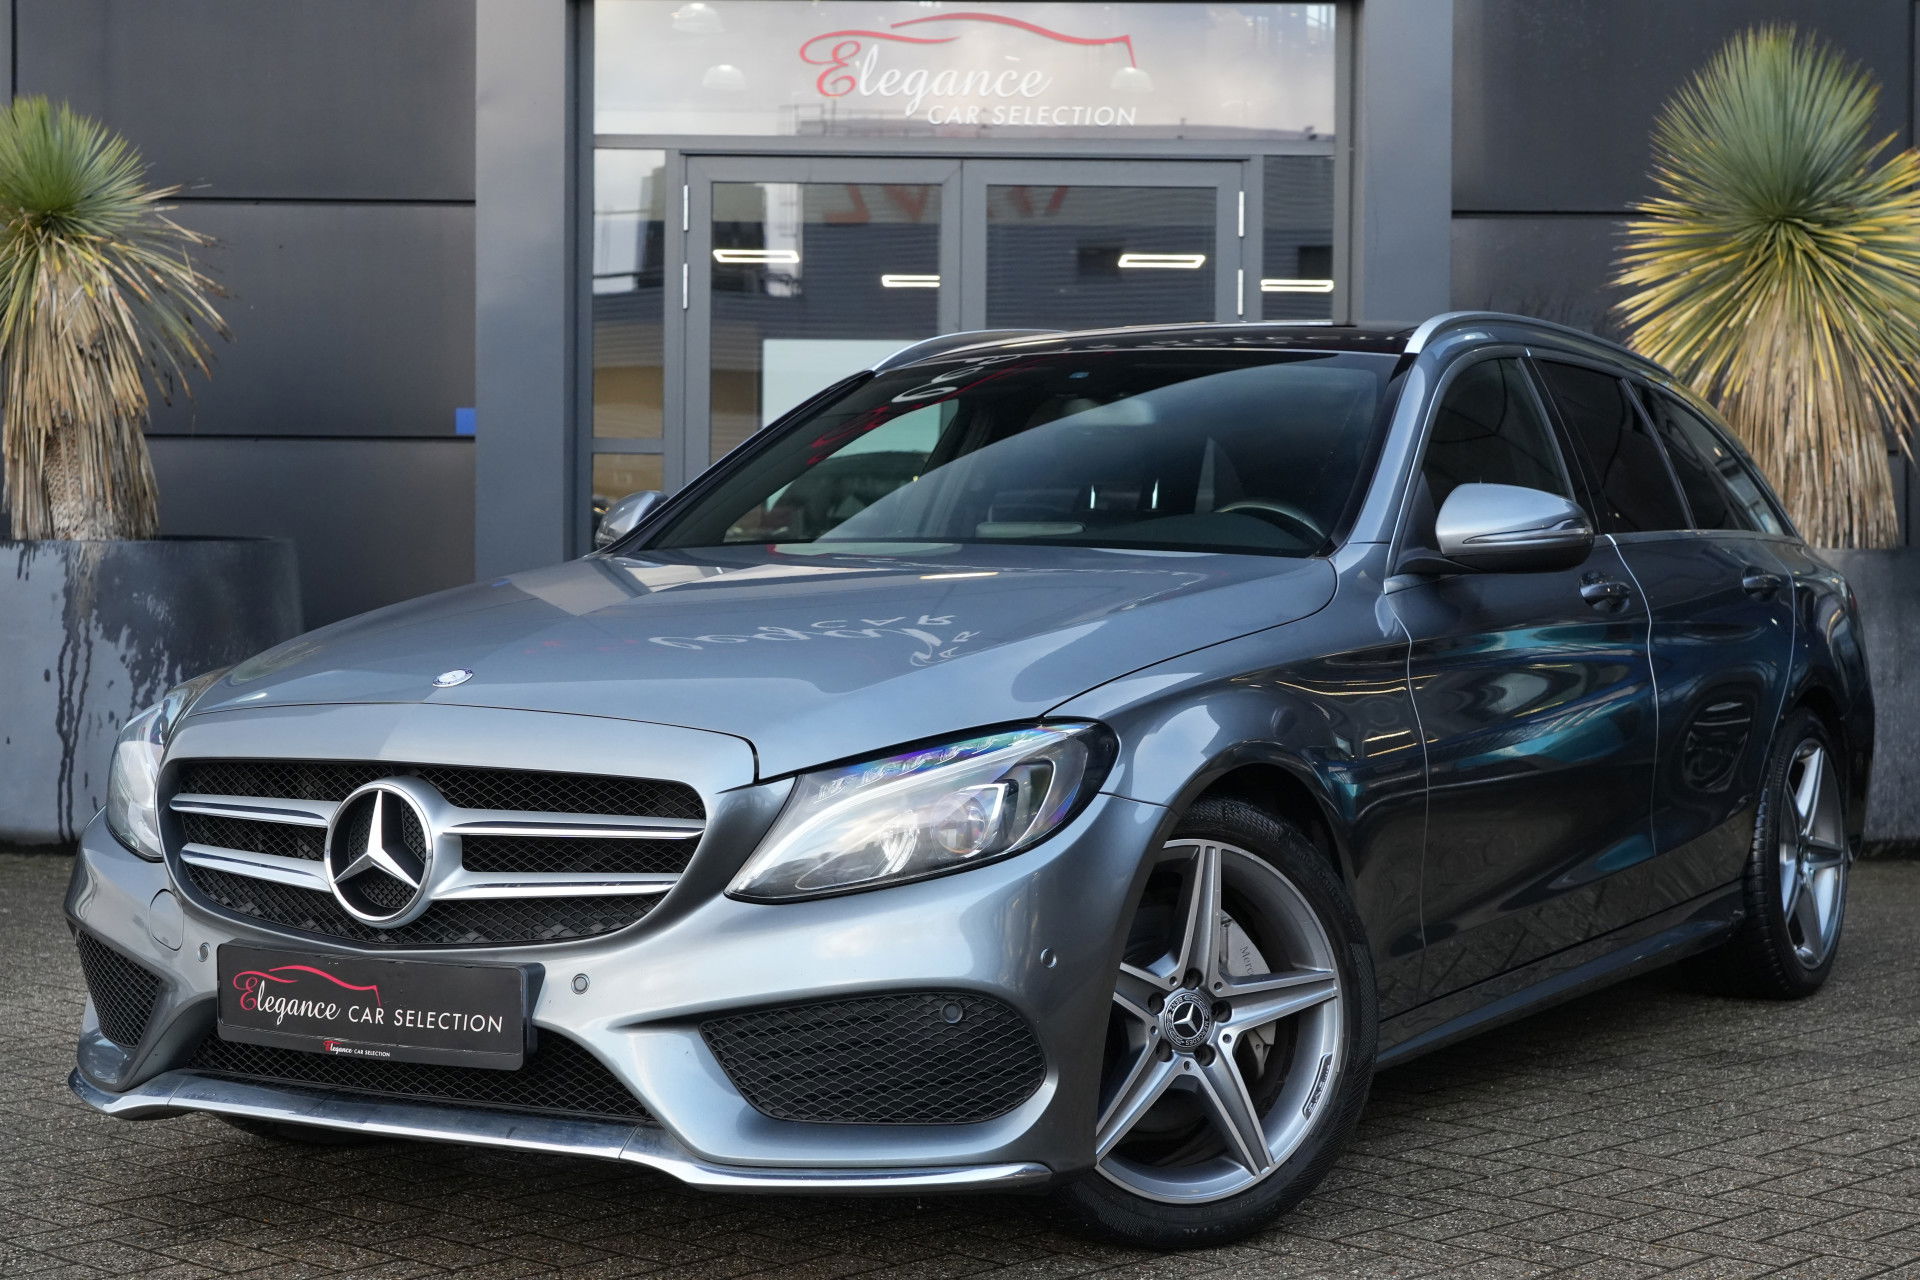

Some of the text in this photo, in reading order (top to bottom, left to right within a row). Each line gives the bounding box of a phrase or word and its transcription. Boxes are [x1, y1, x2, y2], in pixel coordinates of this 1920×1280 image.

[802, 38, 1052, 117] Elegance
[927, 105, 1137, 127] CAR SELECTION
[1240, 945, 1255, 975] Merc
[233, 975, 504, 1034] Elegance CAR SELECTION
[323, 1041, 353, 1055] Elegance
[364, 1049, 391, 1057] SELECTION
